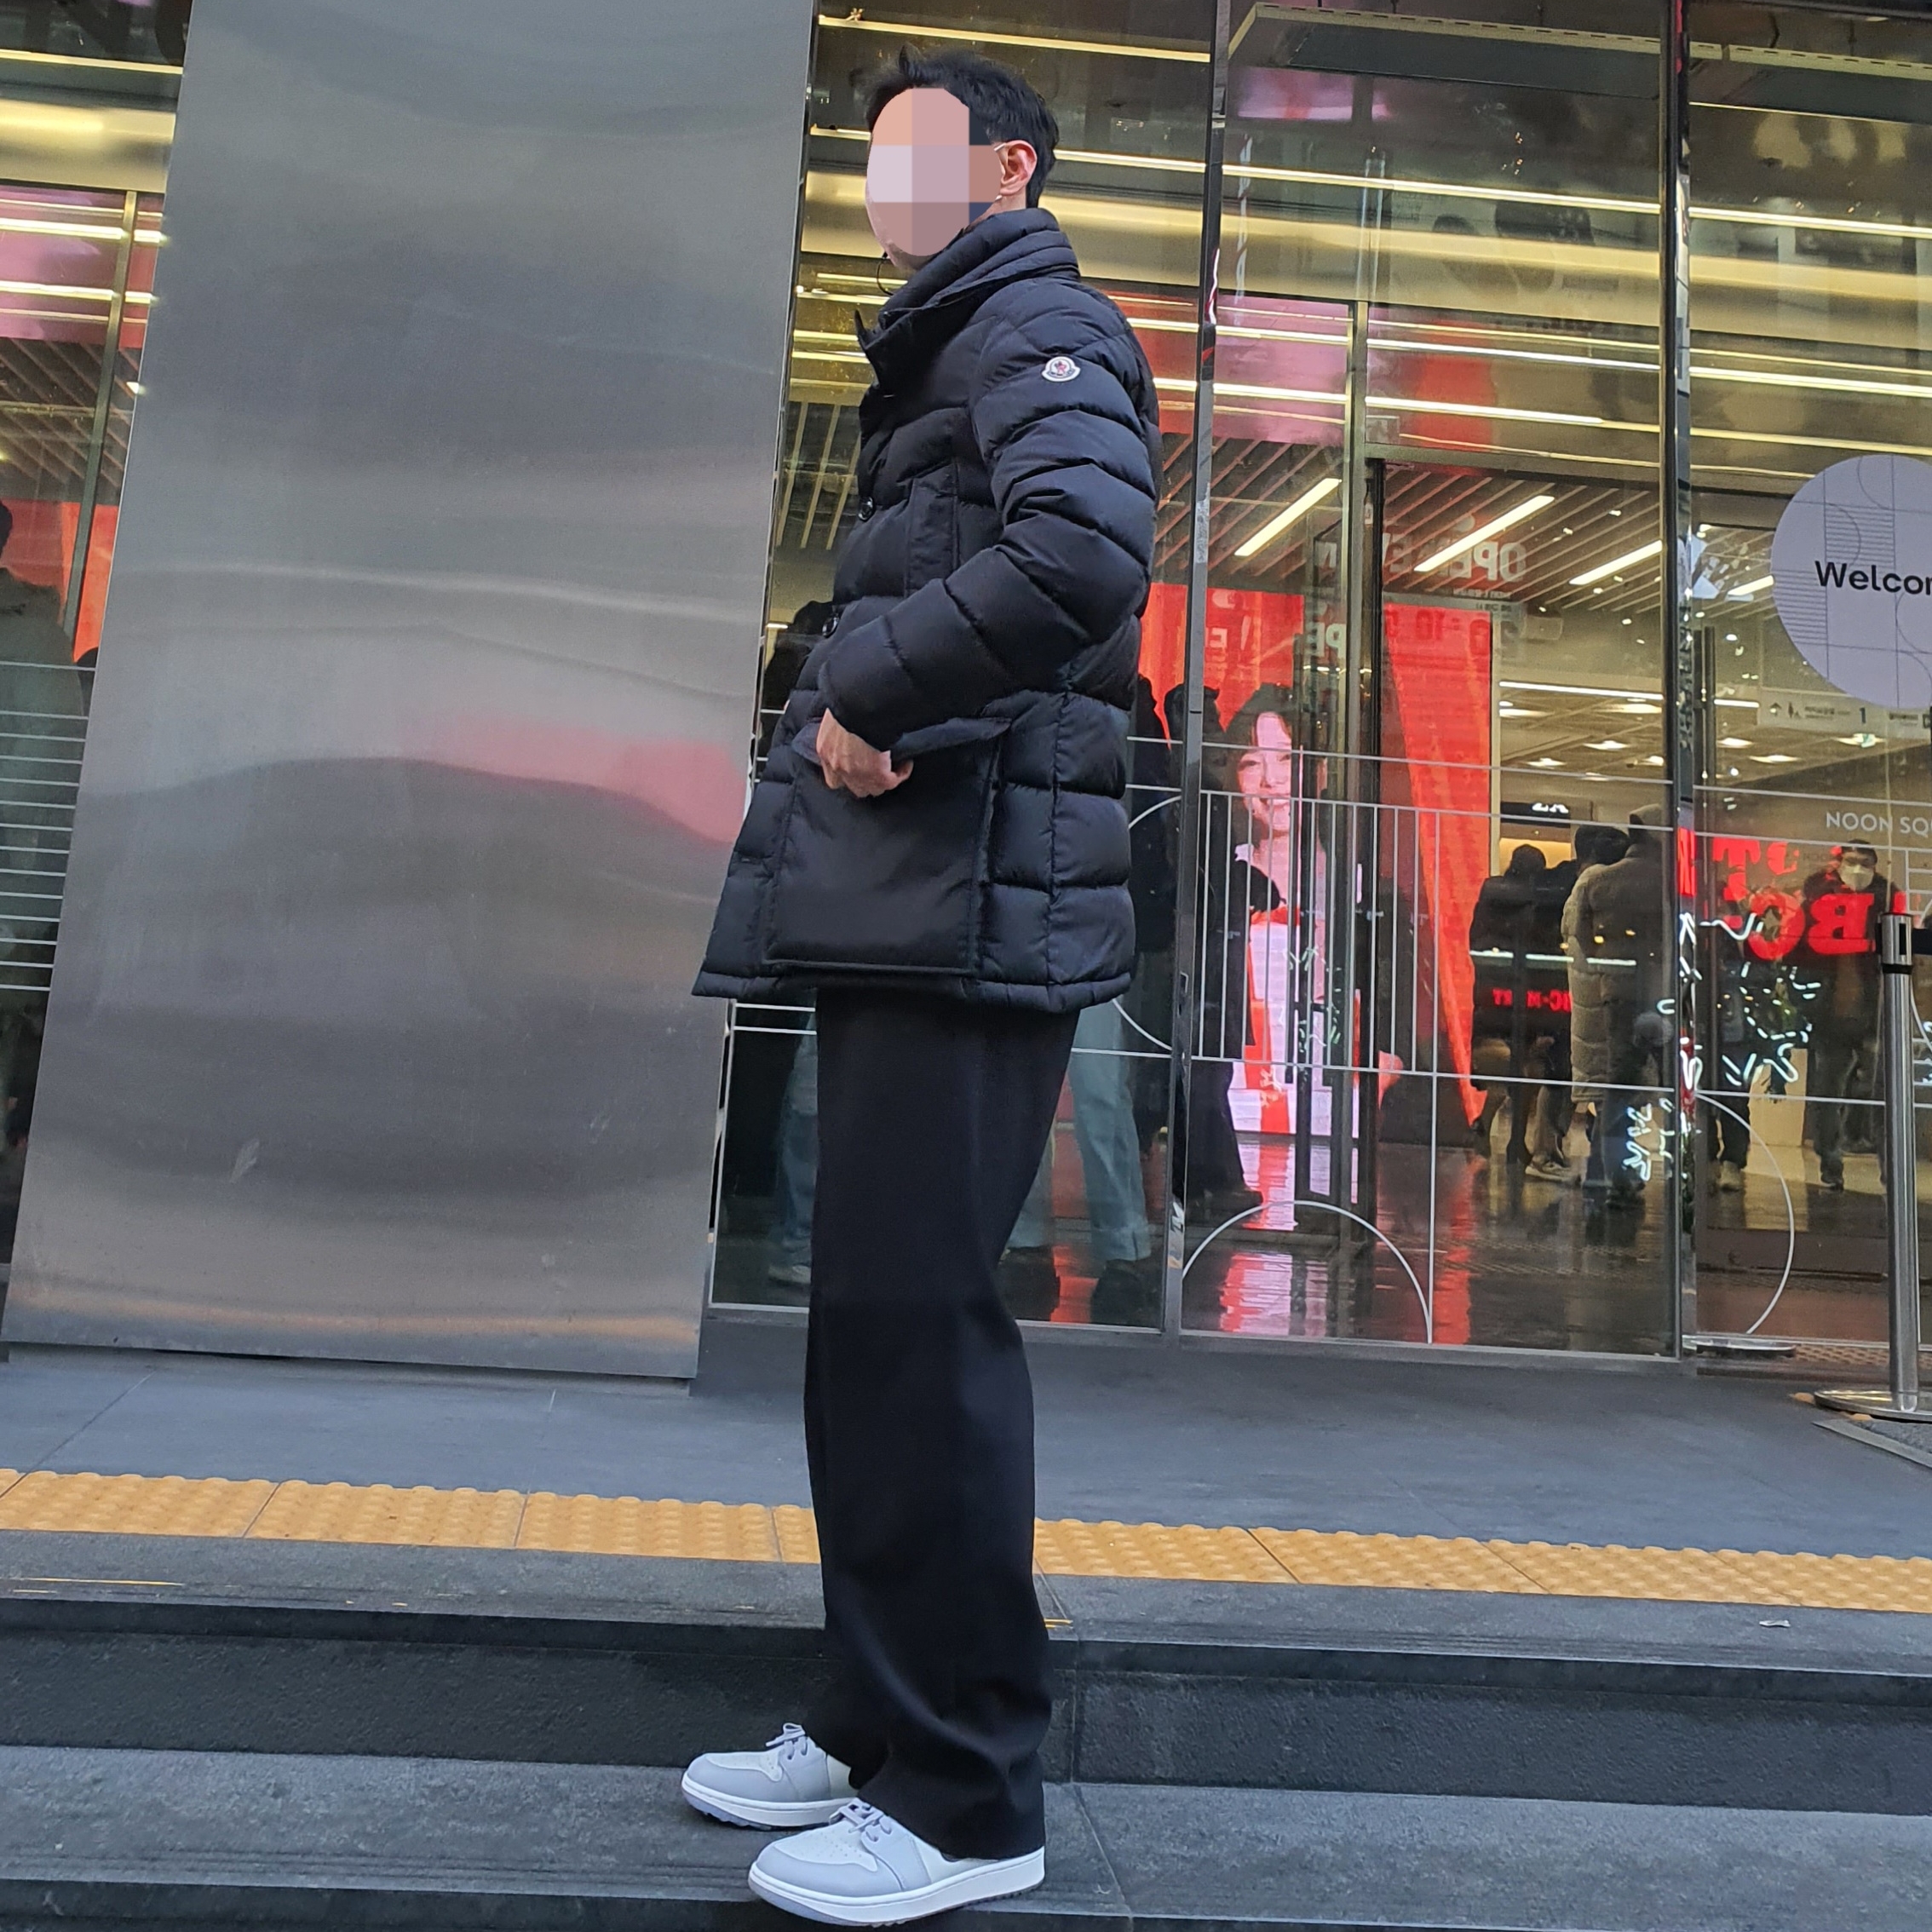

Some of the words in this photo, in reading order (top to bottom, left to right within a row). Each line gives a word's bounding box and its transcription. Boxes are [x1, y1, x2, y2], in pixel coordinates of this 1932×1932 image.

[1814, 561, 1932, 595] Welco
[1826, 812, 1892, 831] NOON
[1900, 816, 1932, 837] SQ
